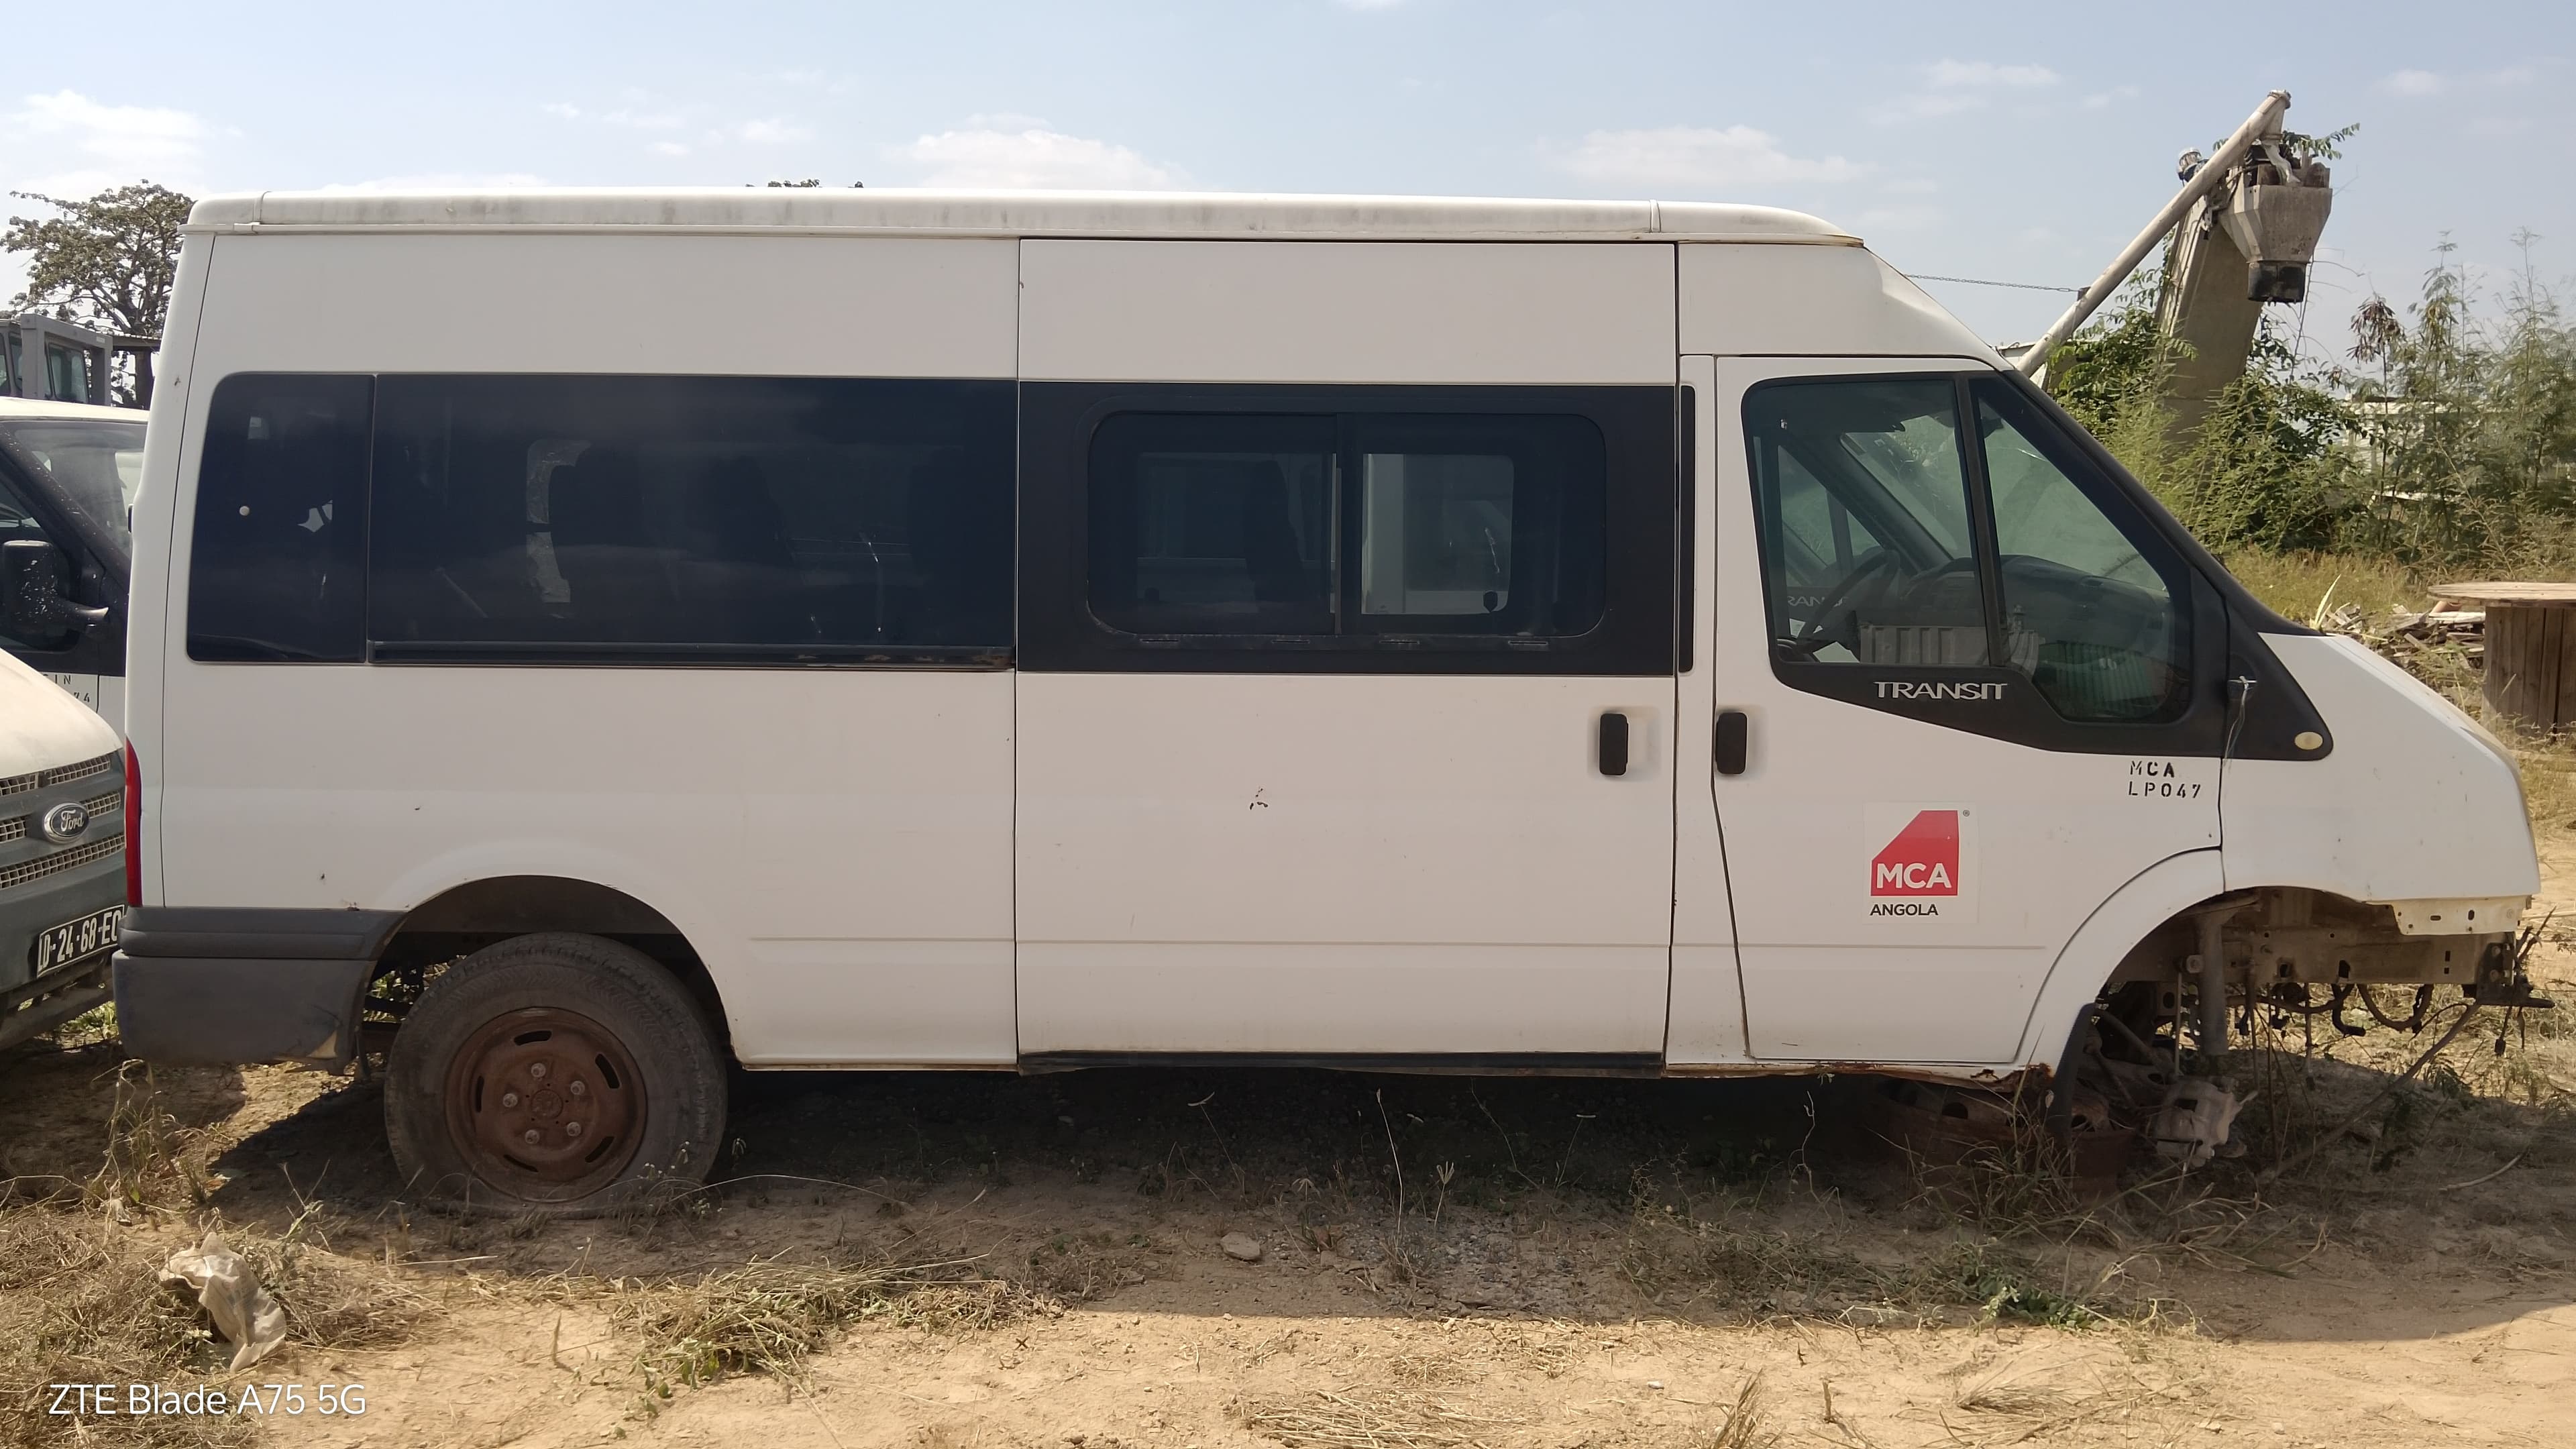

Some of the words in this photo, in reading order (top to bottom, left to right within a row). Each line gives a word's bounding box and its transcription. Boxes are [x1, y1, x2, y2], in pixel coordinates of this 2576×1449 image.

[42, 674, 72, 685] IN
[1873, 681, 2008, 700] TRANSIT
[2130, 760, 2175, 778] MCA
[60, 809, 85, 832] Ford
[1876, 862, 1952, 889] MCA
[1870, 903, 1939, 916] ANGOLA
